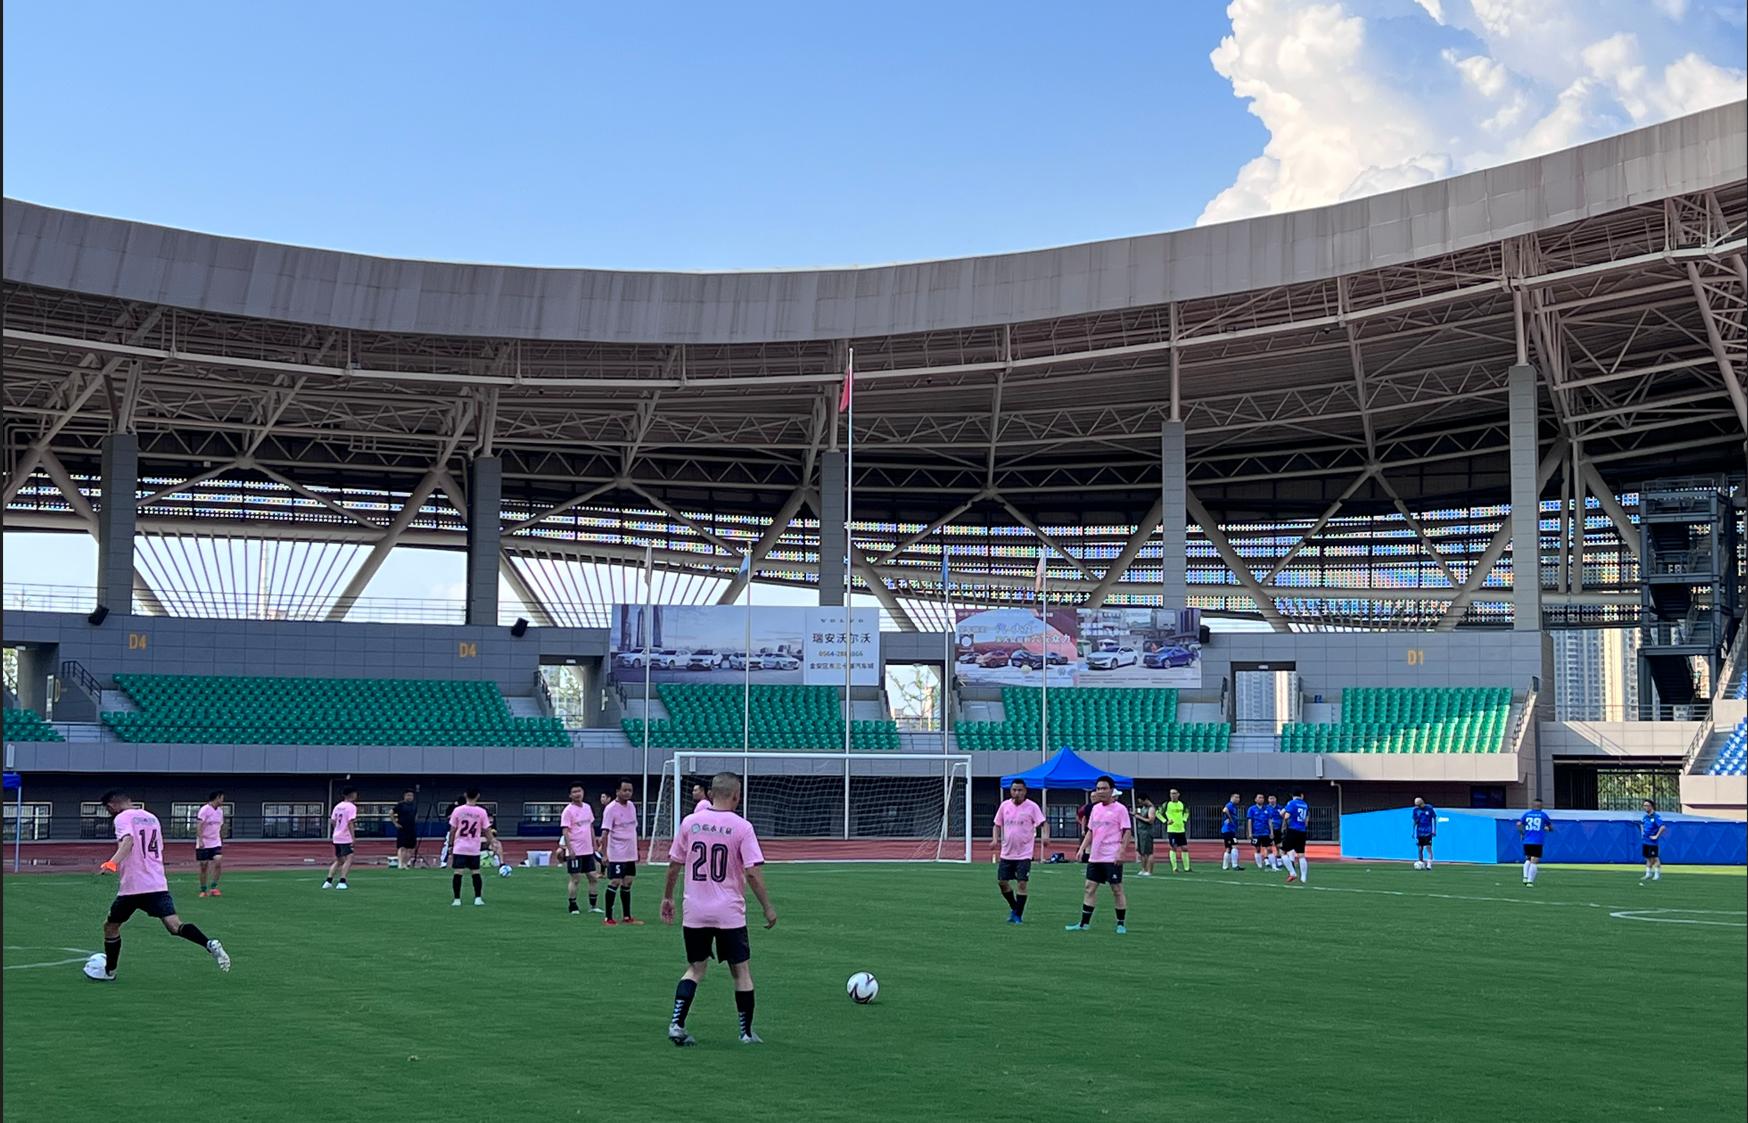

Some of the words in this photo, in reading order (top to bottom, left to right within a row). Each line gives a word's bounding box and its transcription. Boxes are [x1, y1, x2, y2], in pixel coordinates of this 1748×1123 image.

[128, 633, 147, 650] D4
[812, 633, 871, 644] 瑞安沃尔沃
[459, 642, 477, 658] D4
[1407, 649, 1424, 666] D1
[459, 819, 478, 838] 24
[1525, 817, 1541, 831] 39
[139, 829, 159, 859] 14
[691, 841, 729, 882] 20
